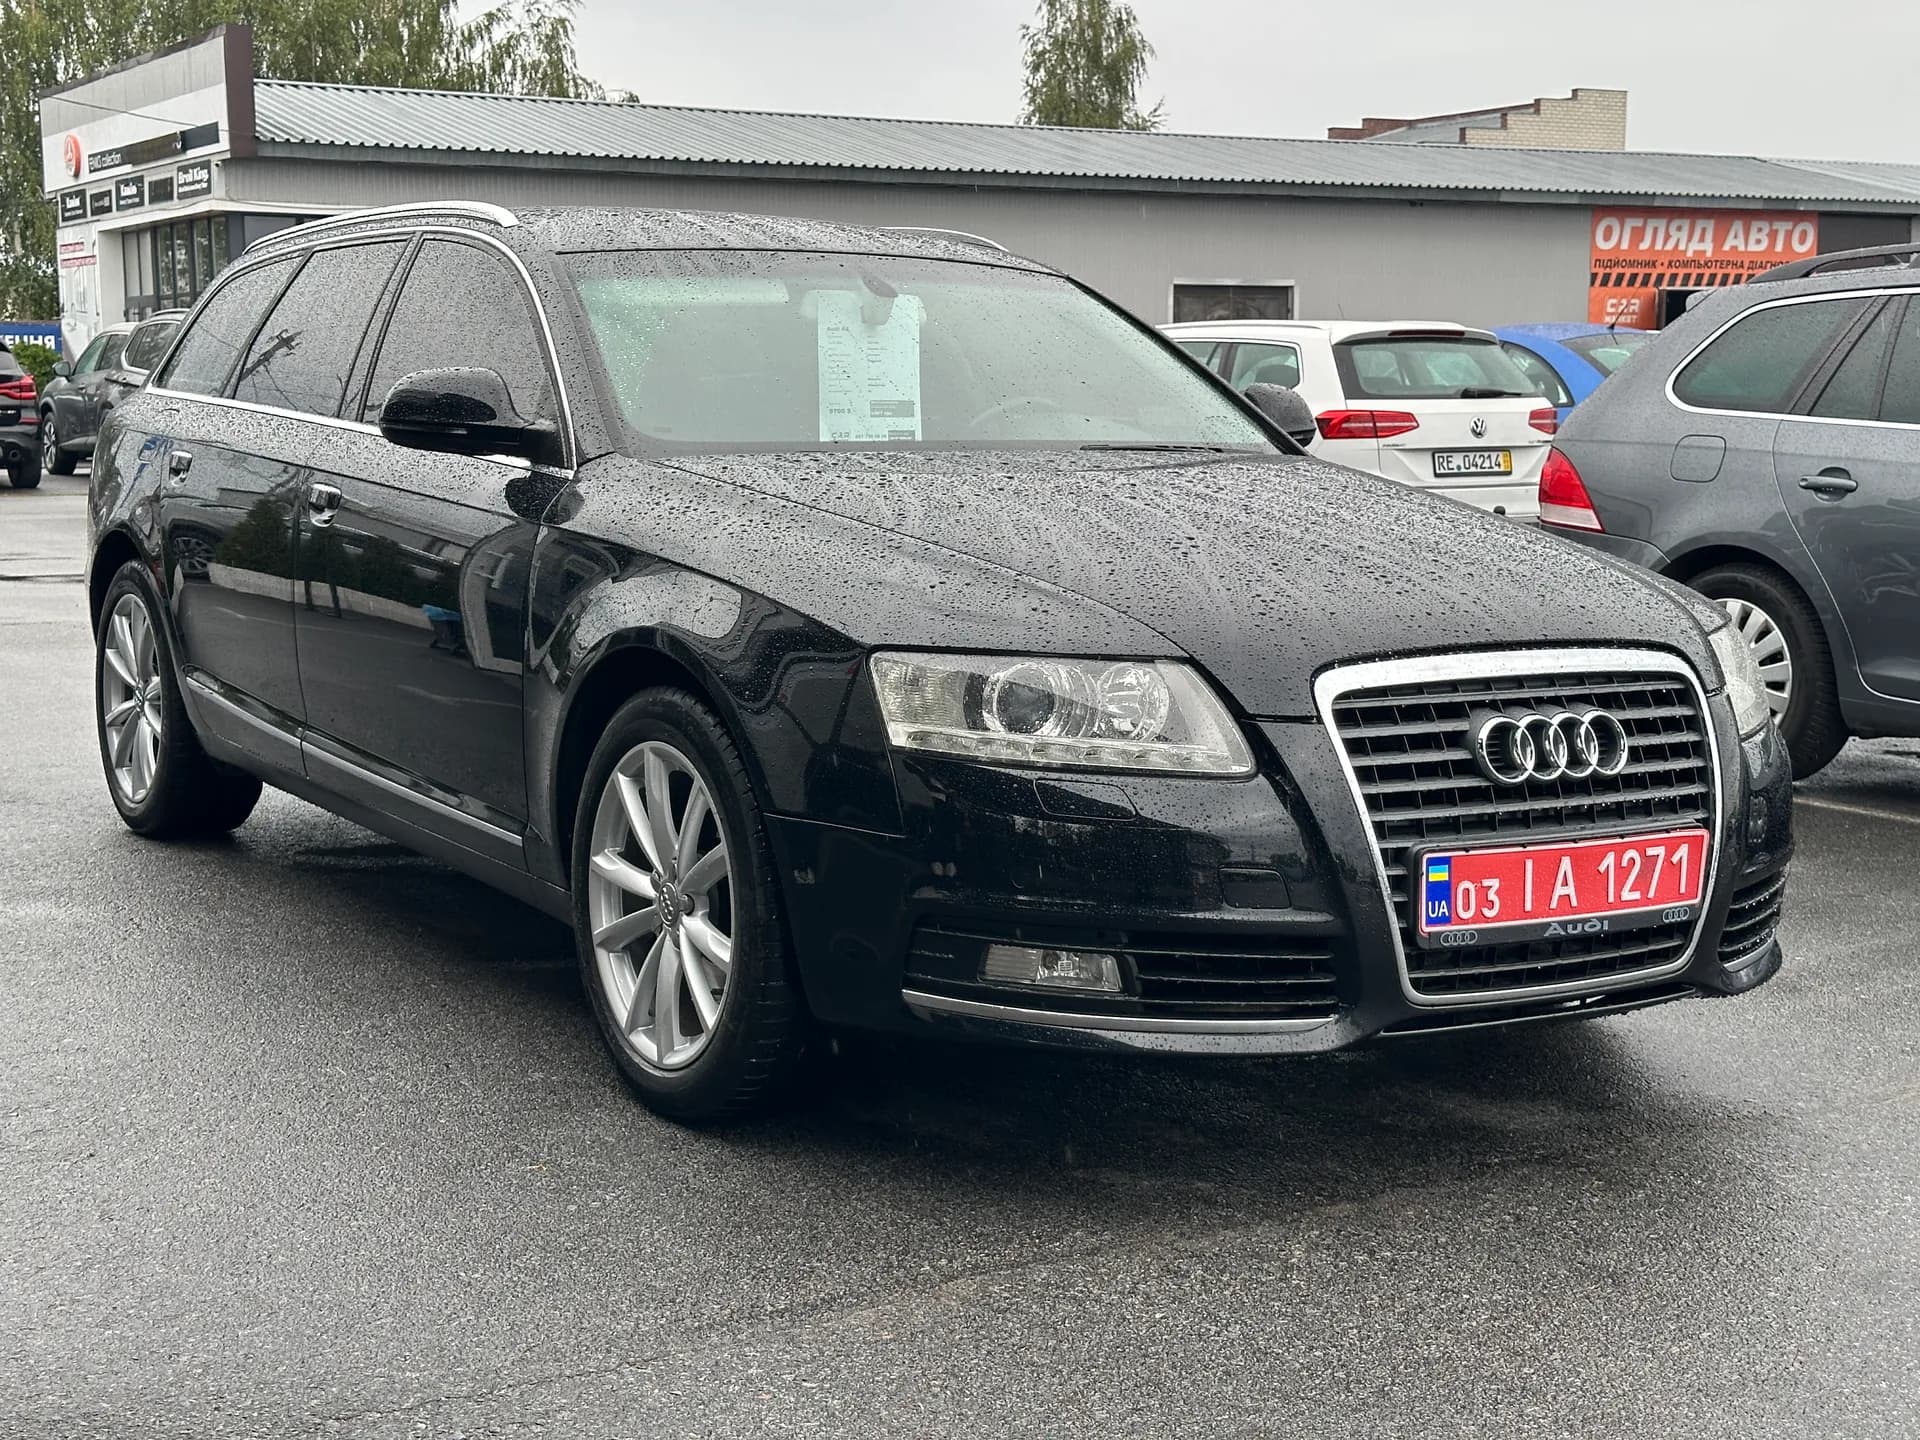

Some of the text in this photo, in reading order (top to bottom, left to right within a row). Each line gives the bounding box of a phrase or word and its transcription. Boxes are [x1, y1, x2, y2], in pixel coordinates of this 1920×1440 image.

[1595, 217, 1815, 257] ОГЛЯД АВТО
[1594, 257, 1658, 270] ПІДЙОМНИК
[1667, 259, 1745, 270] КОМПЬЮТЕРНА
[1606, 298, 1640, 313] CAR
[1437, 455, 1455, 471] RE
[1463, 453, 1501, 470] 04214
[1456, 878, 1500, 919] 03
[1598, 843, 1689, 904] 1271
[1428, 901, 1448, 917] UA
[1544, 918, 1609, 938] Audi
